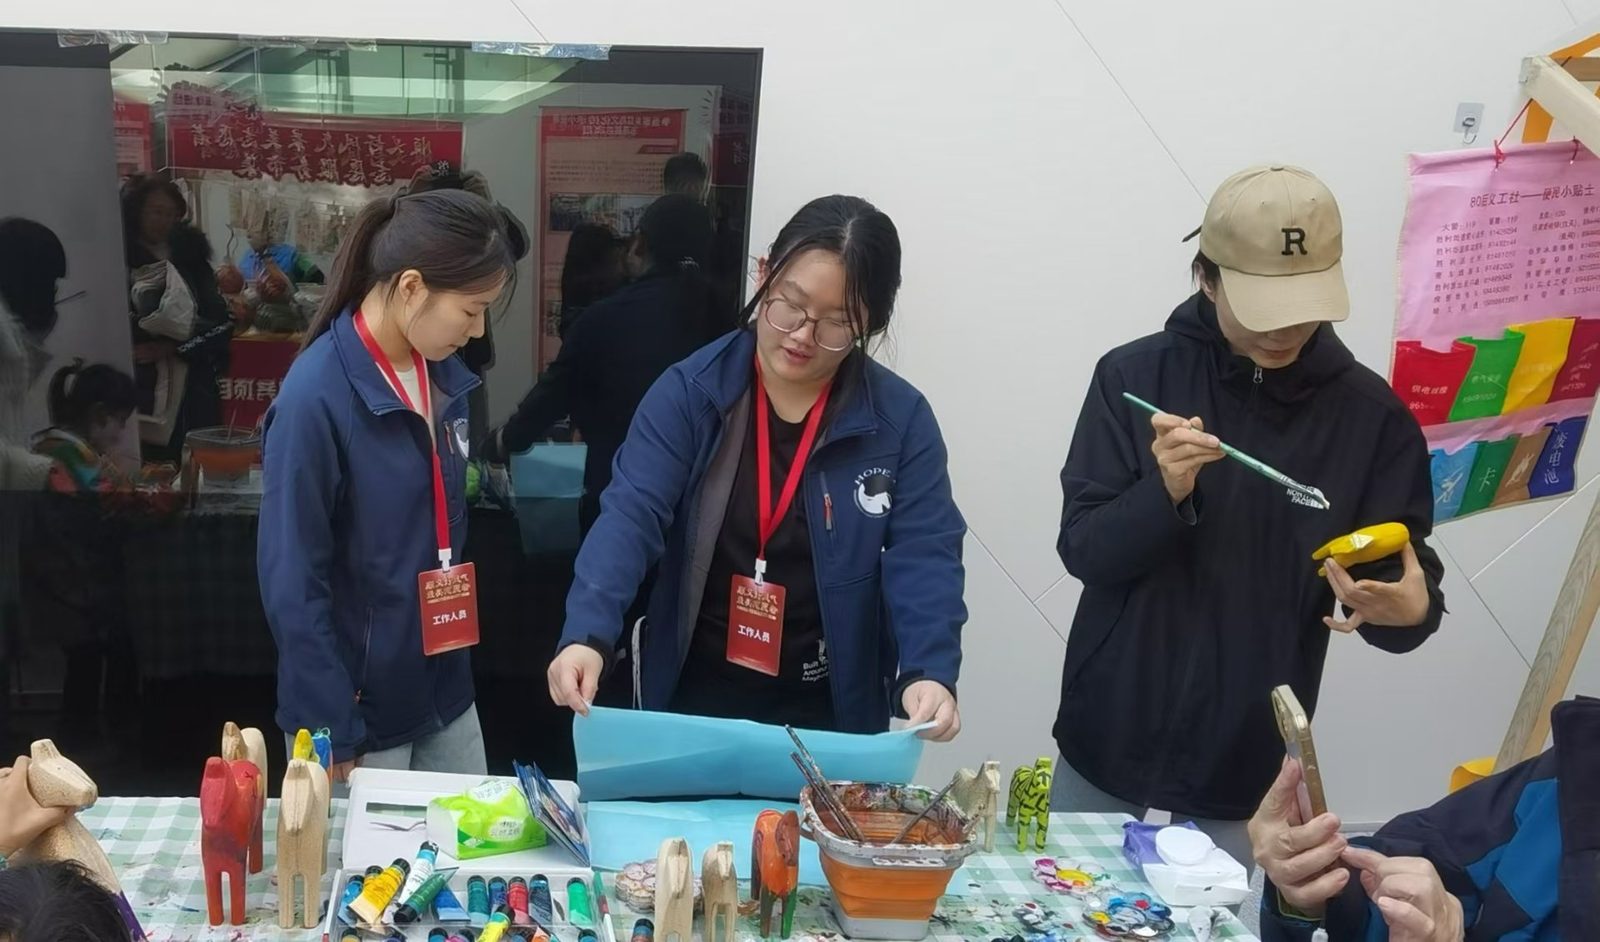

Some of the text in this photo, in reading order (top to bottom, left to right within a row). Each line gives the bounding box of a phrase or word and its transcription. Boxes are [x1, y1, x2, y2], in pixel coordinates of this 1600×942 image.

[1281, 228, 1307, 255] R
[854, 467, 892, 485] HOPE
[432, 609, 467, 625] 工作人员
[738, 624, 770, 643] 工作人员
